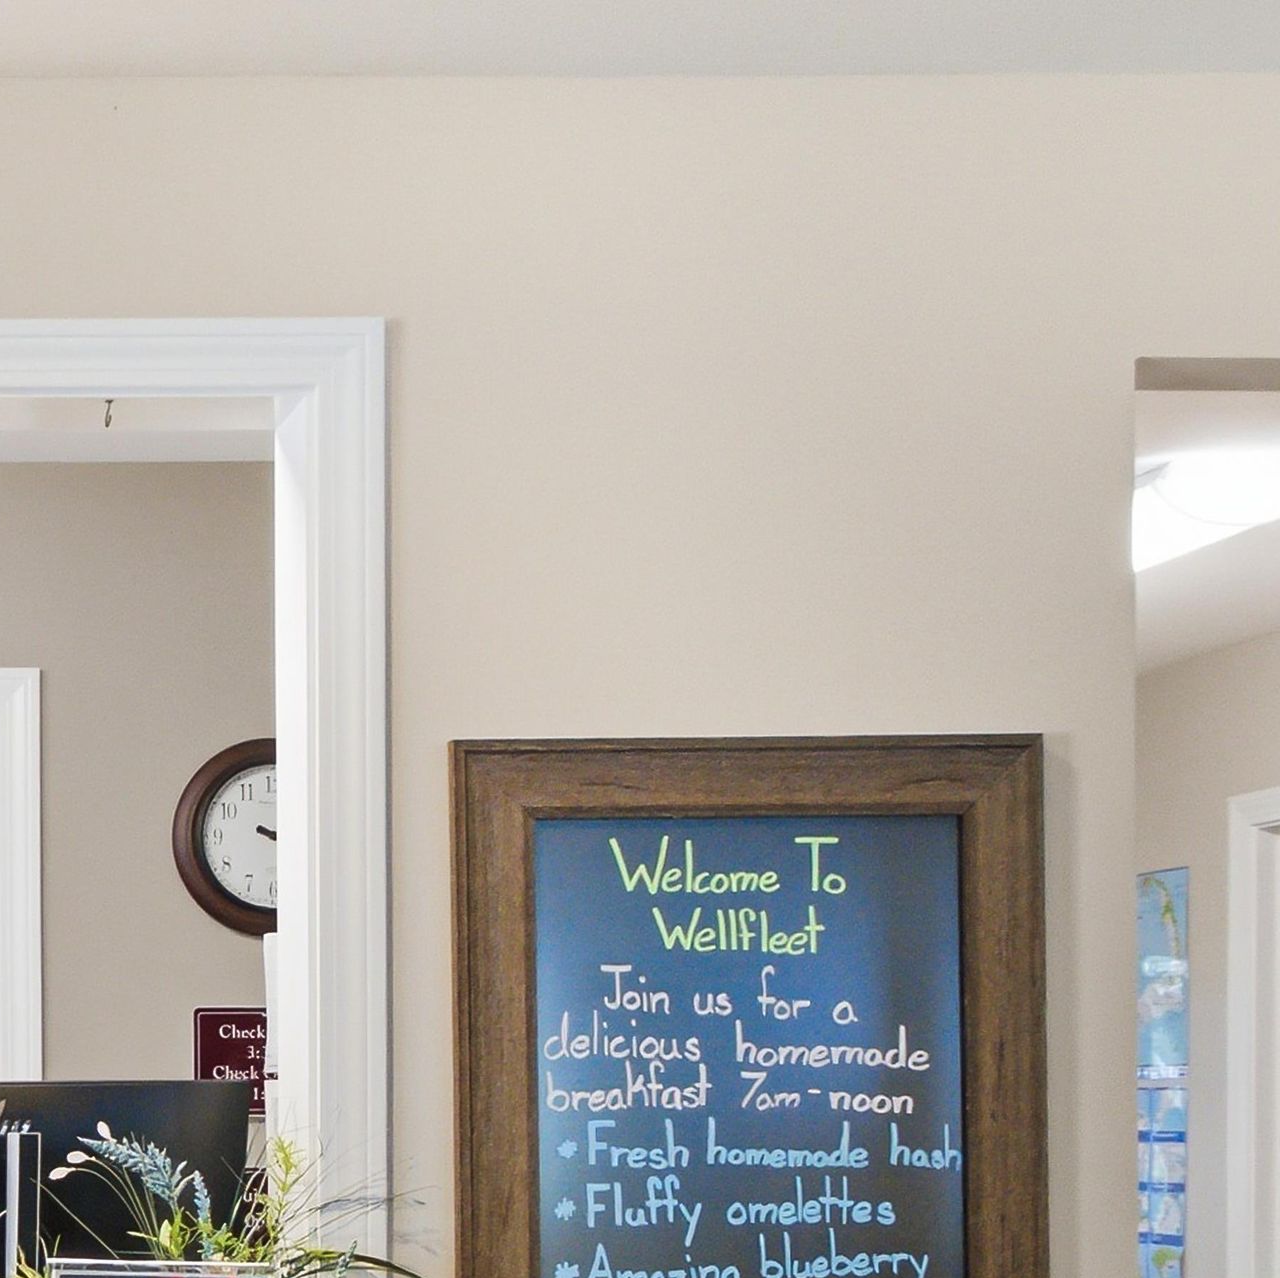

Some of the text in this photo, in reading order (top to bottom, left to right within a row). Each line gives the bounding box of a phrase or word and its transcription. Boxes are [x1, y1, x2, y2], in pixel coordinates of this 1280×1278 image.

[240, 783, 253, 801] 11
[221, 802, 237, 820] 10
[213, 829, 223, 845] 9
[222, 855, 232, 872] 8
[609, 836, 846, 894] Welcome To
[245, 874, 254, 892] 7
[652, 905, 825, 954] Wellfleet
[600, 964, 858, 1024] Join us for a
[219, 1024, 266, 1039] Check
[543, 1010, 931, 1071] delicious homemade
[212, 1065, 260, 1080] Check
[546, 1060, 712, 1111] breakfast
[587, 1116, 962, 1171] Fresh homemade hash
[586, 1175, 897, 1247] Fluffy omelettes
